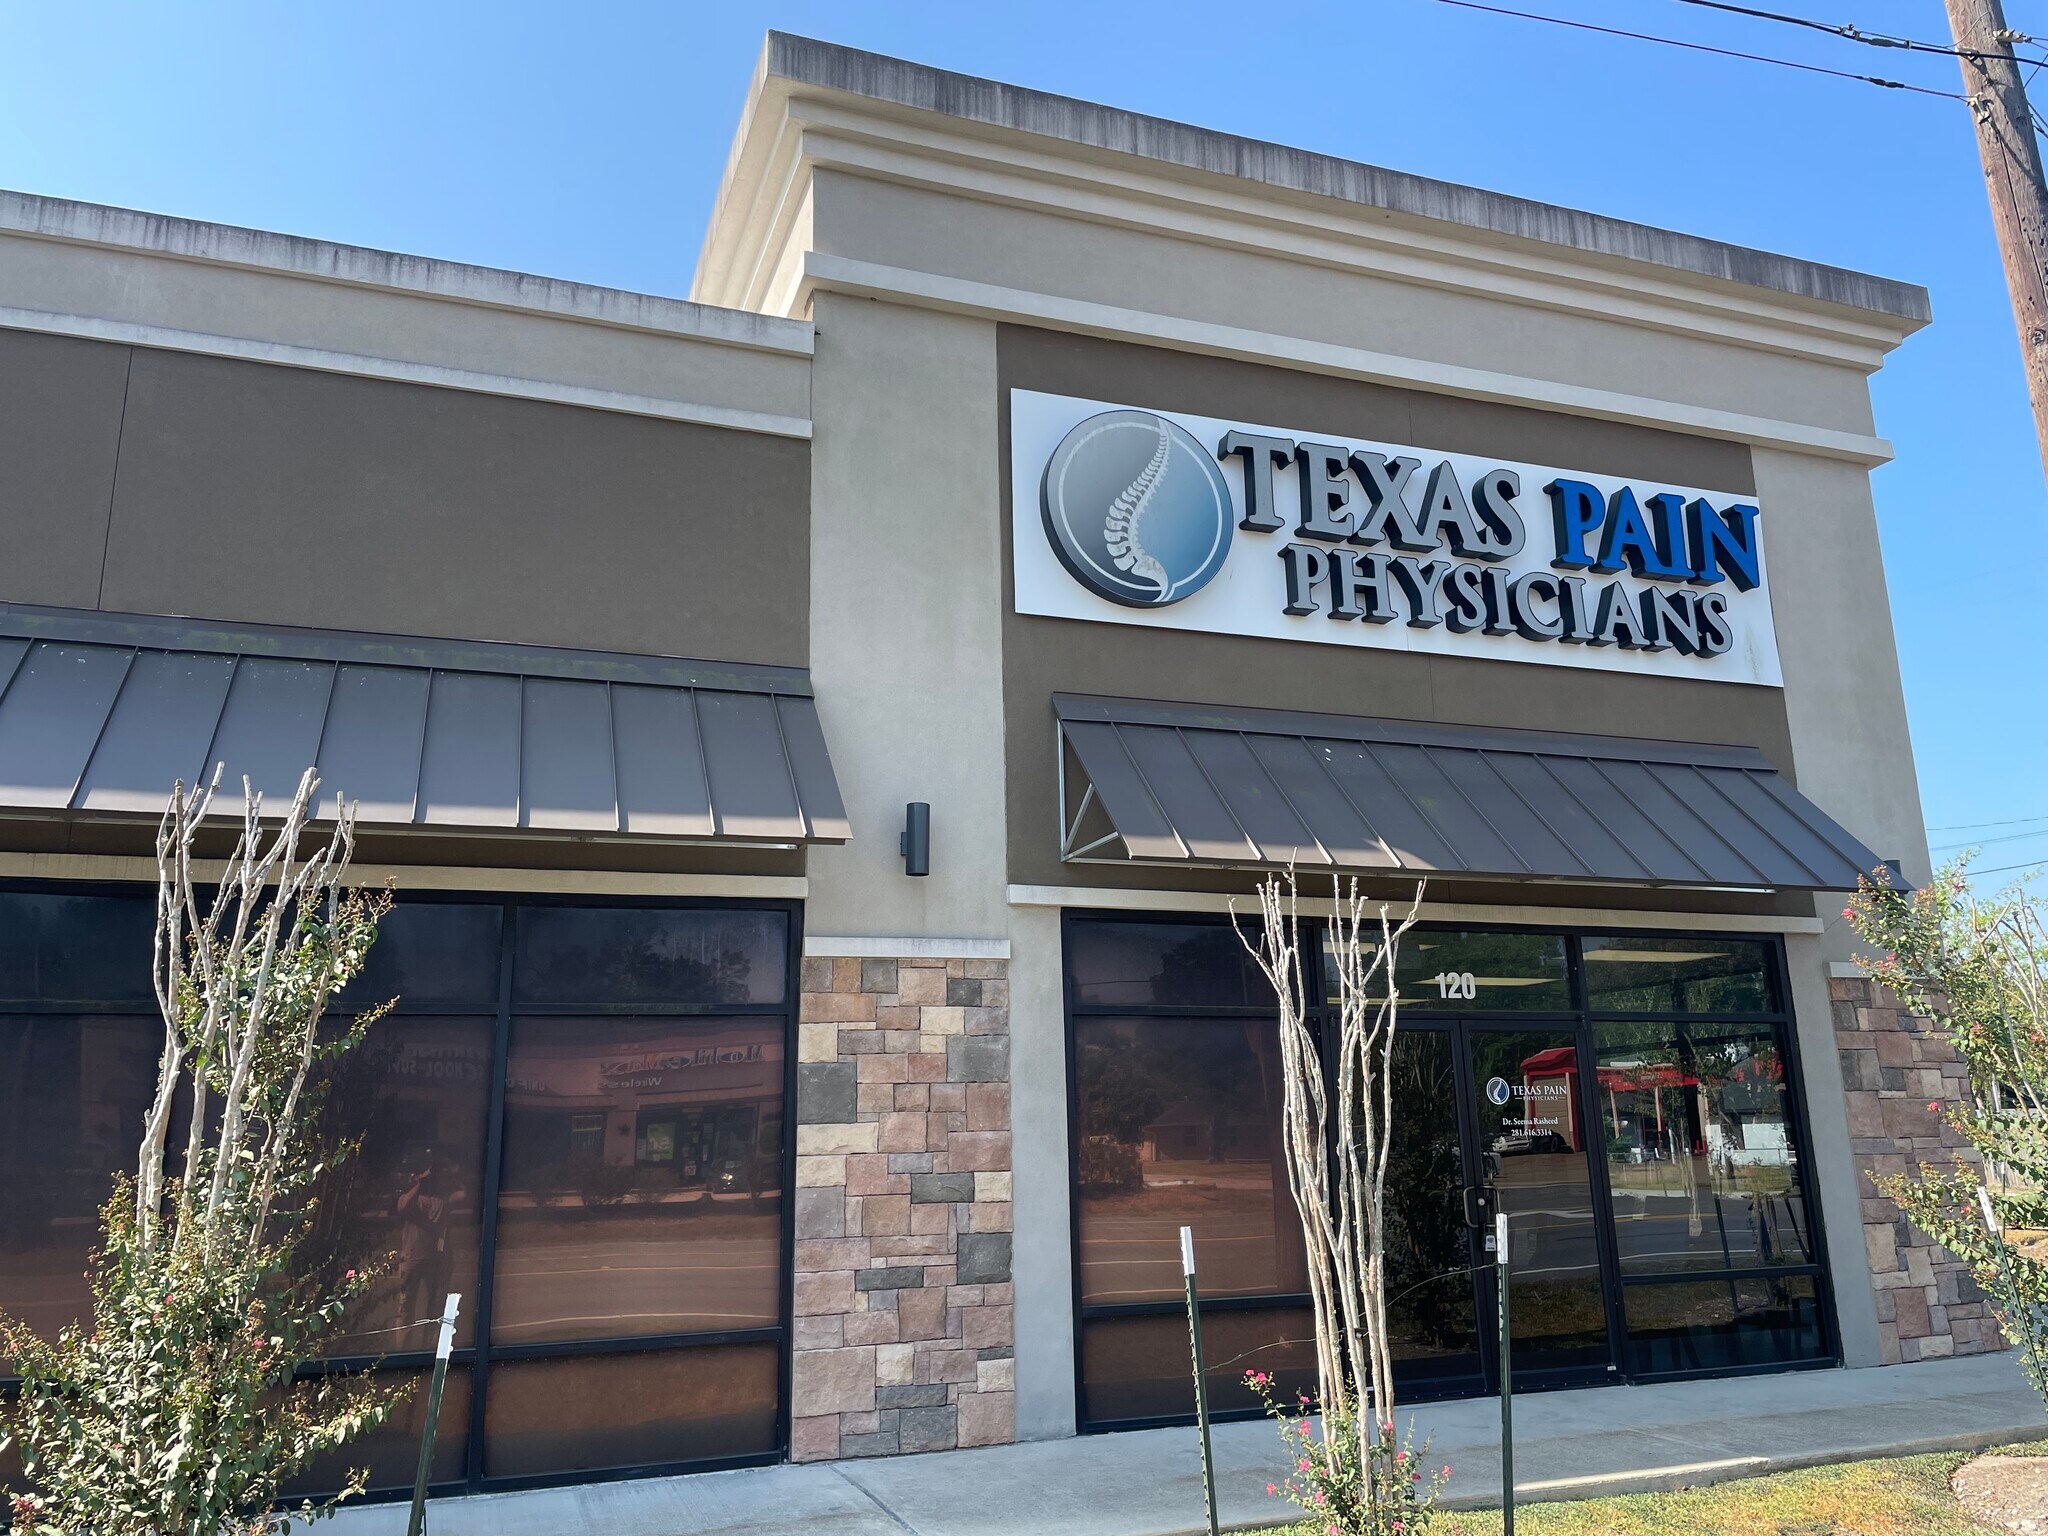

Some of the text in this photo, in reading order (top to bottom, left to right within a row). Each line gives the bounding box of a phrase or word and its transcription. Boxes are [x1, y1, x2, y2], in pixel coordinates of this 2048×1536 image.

[1218, 430, 1760, 593] TEXAS PAIN
[1277, 543, 1734, 658] PHYSICIANS
[1435, 972, 1476, 1000] 120
[1511, 1085, 1567, 1096] TEXAS PAIN
[1502, 1117, 1513, 1126] Dr.
